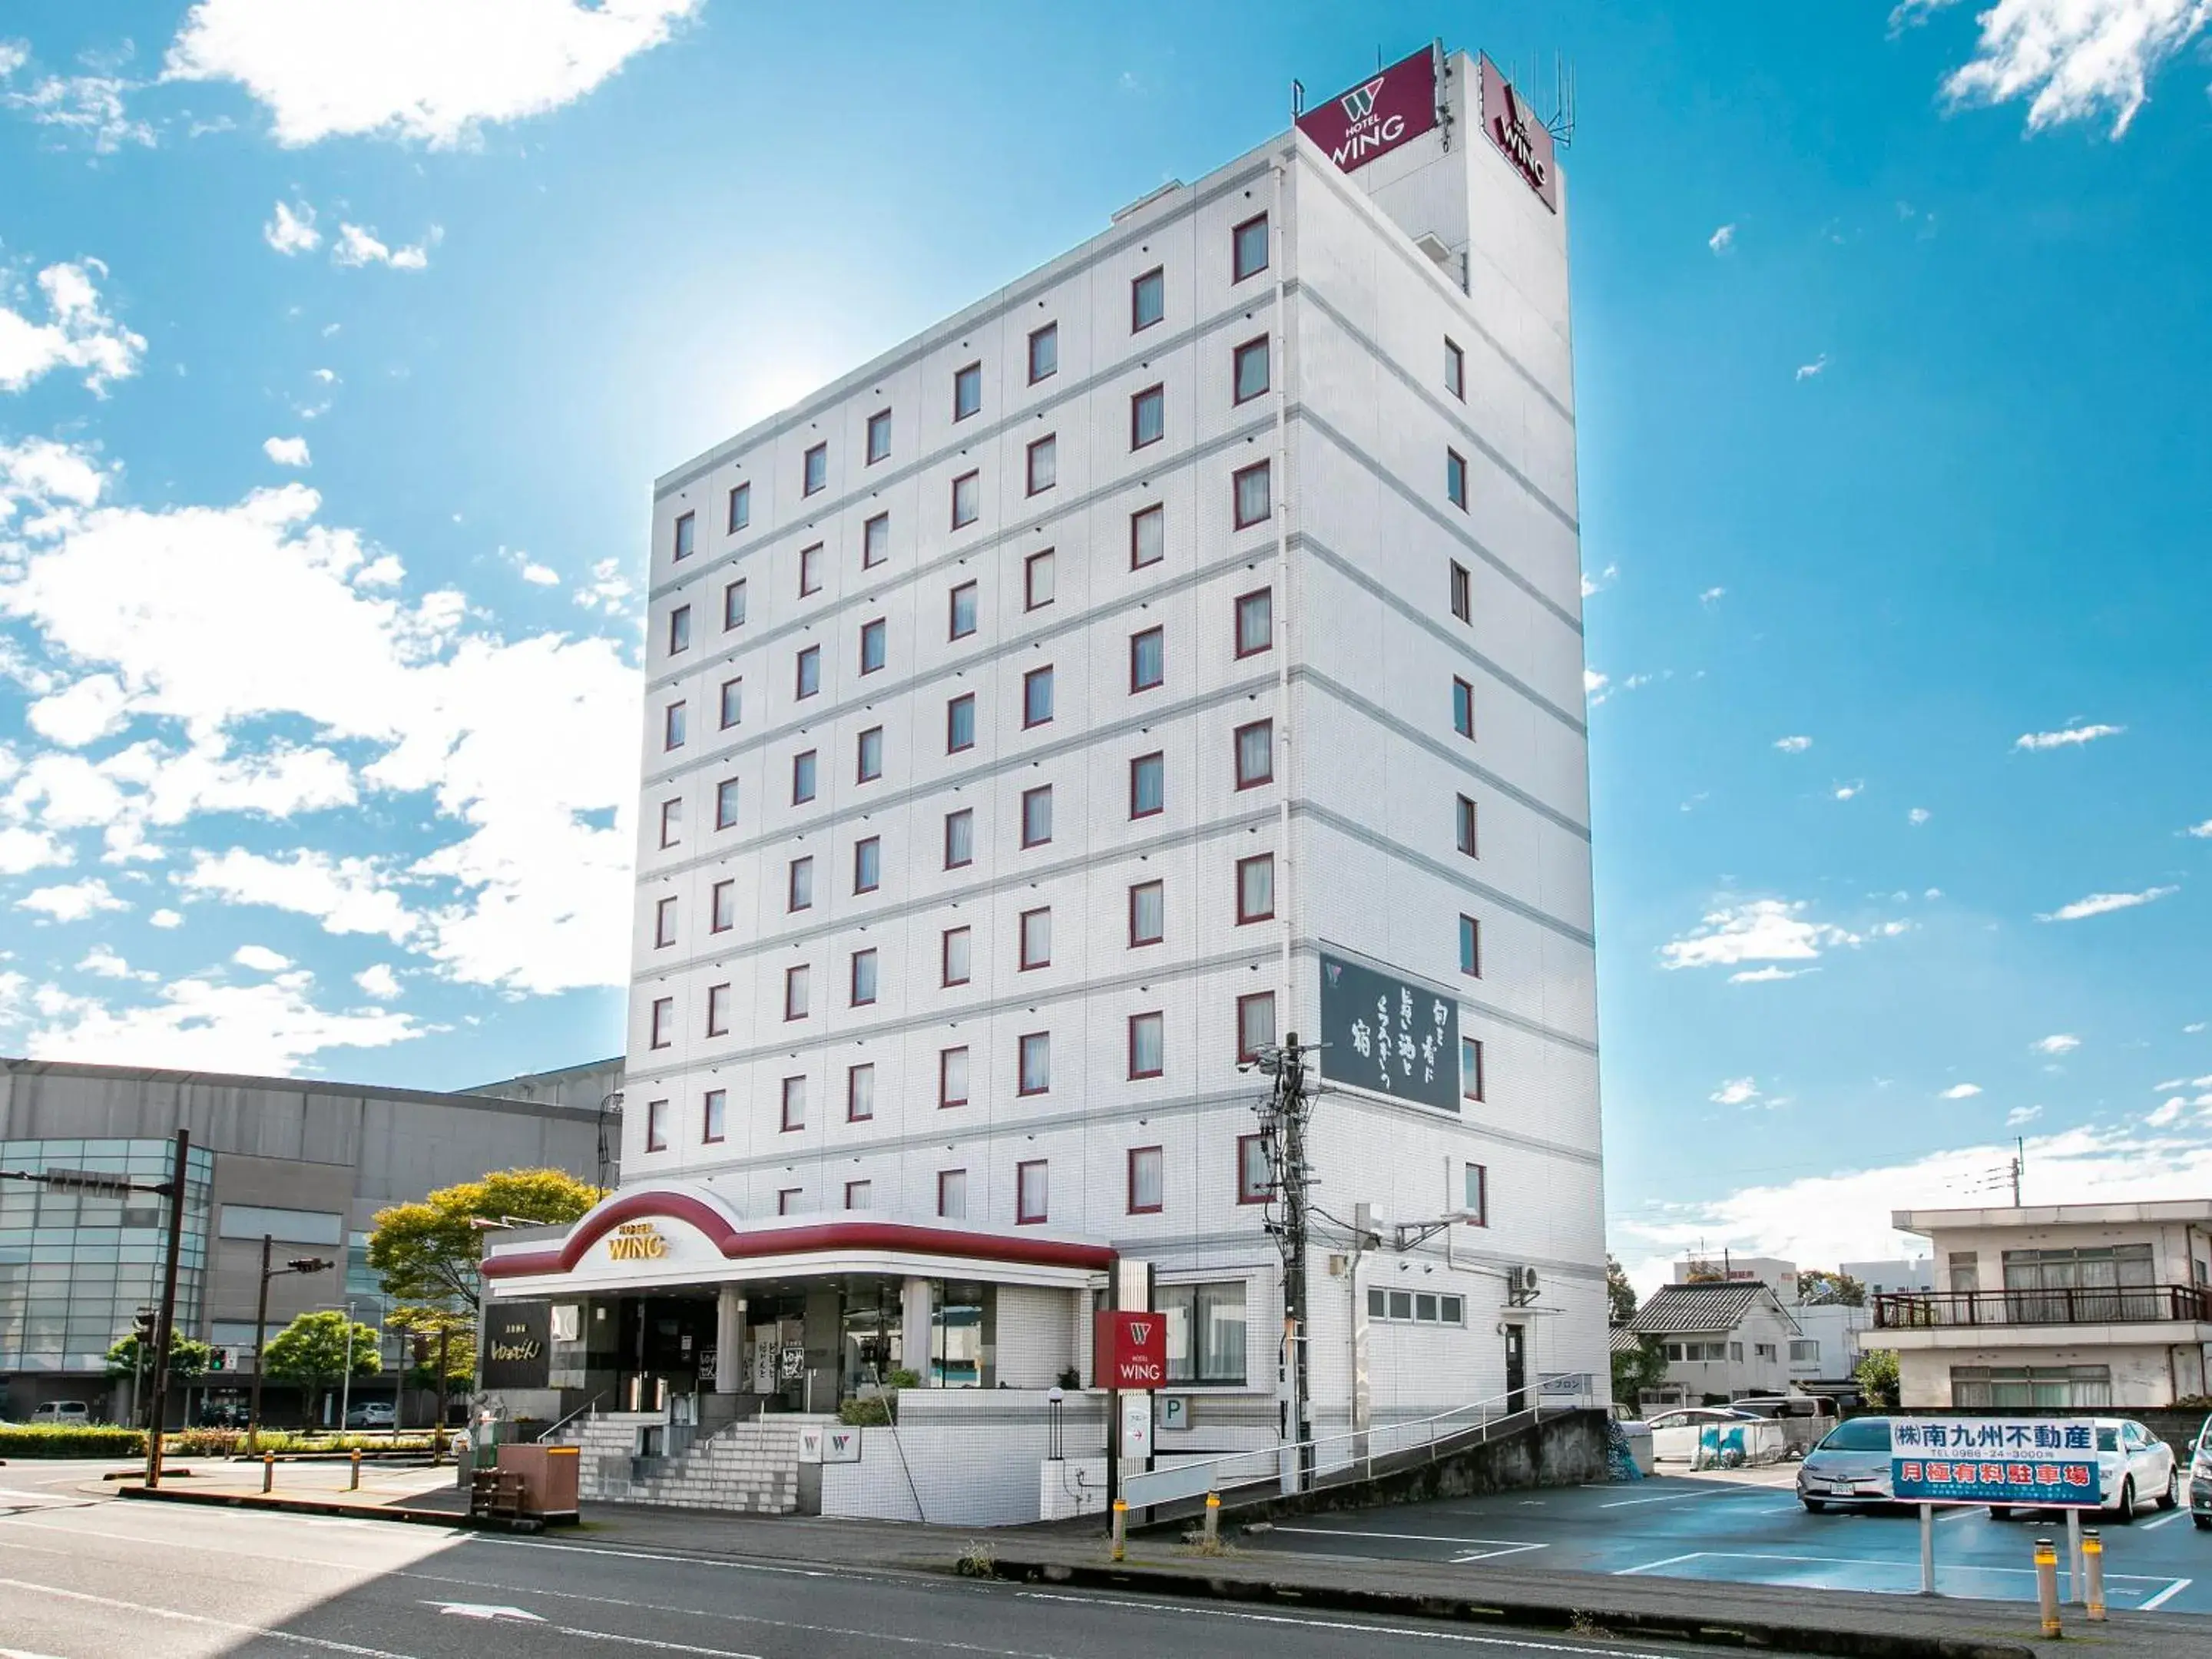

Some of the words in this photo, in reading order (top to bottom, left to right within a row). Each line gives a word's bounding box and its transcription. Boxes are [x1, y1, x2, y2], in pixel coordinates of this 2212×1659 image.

[1346, 113, 1381, 137] HOTEL
[1331, 115, 1405, 165] WING
[608, 1235, 665, 1261] WING
[1120, 1363, 1161, 1380] WING
[1167, 1399, 1181, 1419] P
[1902, 1462, 2091, 1485] 月極有料駐車場
